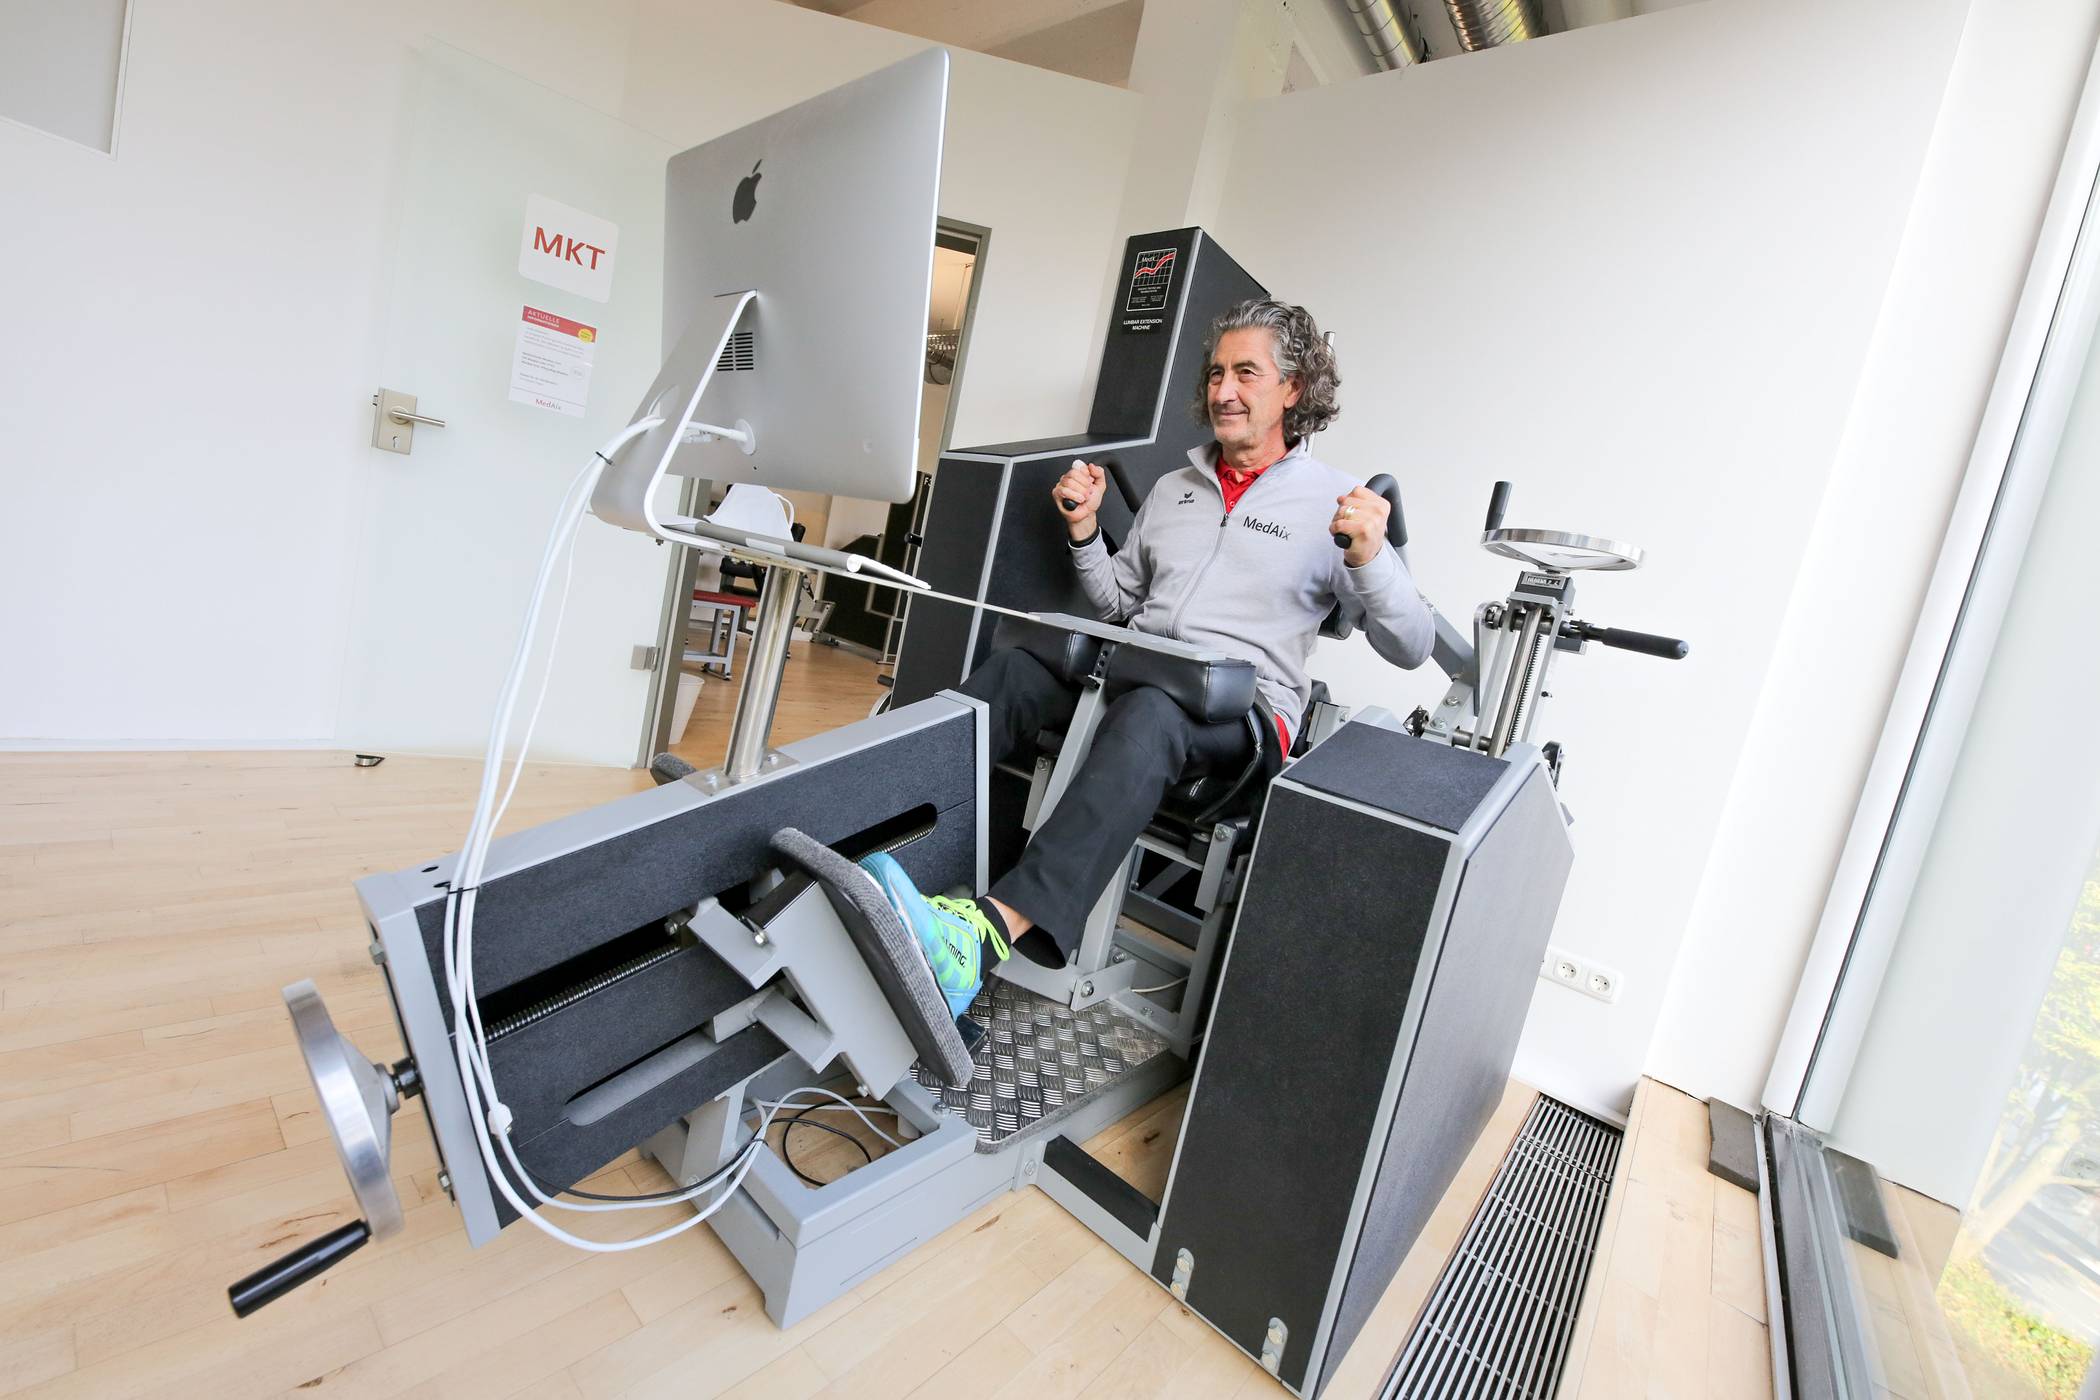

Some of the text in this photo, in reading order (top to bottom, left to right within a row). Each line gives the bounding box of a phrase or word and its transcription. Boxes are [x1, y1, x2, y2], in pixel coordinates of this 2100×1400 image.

[533, 226, 605, 270] MKT
[528, 310, 560, 324] AKTUELLE
[1243, 516, 1291, 540] MedAix
